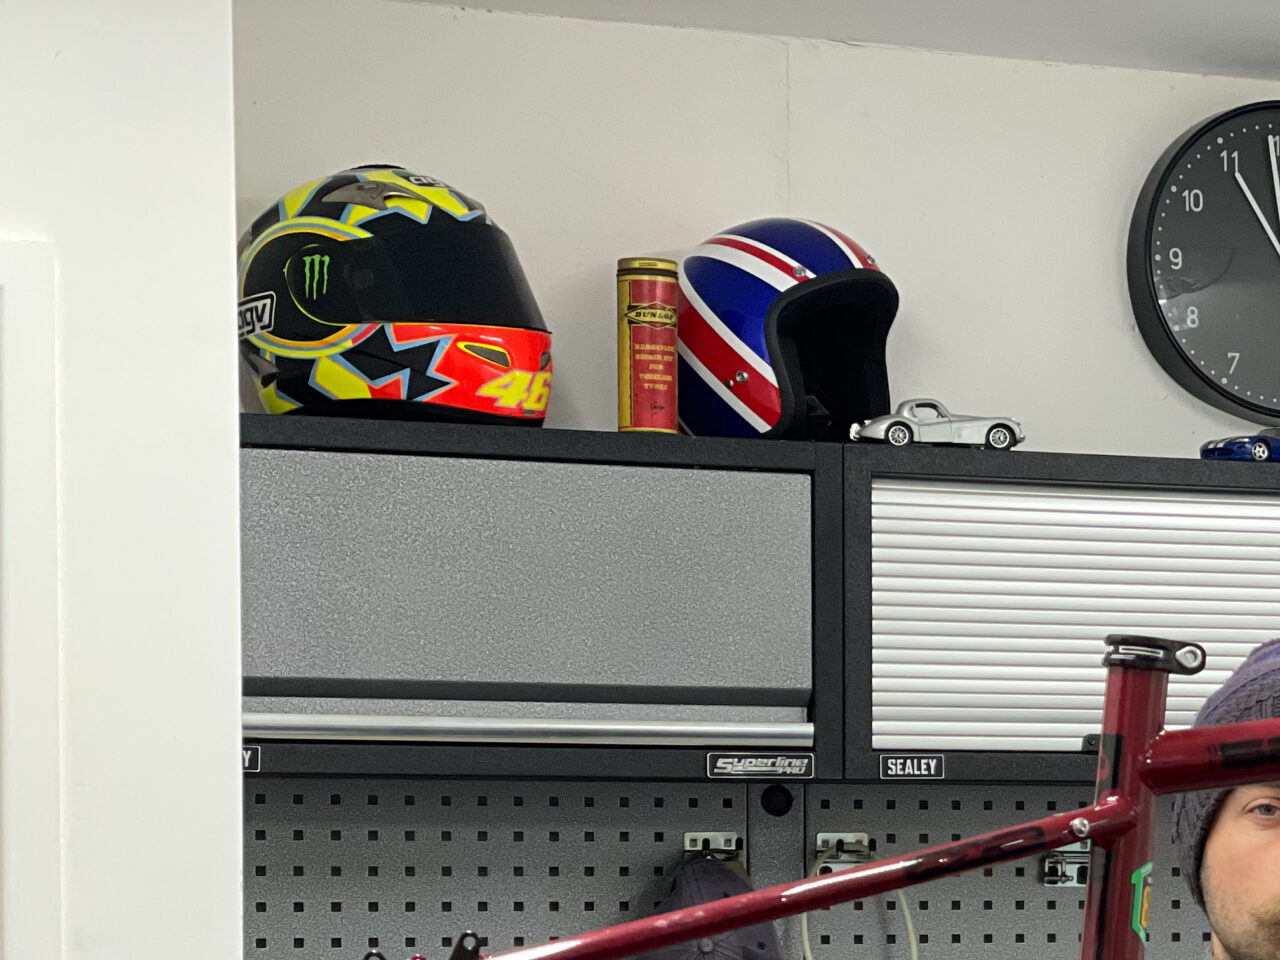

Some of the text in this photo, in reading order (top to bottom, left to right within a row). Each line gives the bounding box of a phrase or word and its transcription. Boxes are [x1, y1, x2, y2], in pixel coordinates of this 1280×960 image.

[1220, 150, 1239, 172] 11
[1181, 189, 1204, 212] 10
[1169, 248, 1183, 269] 9
[634, 310, 675, 321] DUNLOP
[1186, 306, 1199, 328] 8
[1226, 353, 1240, 374] 7
[475, 369, 552, 411] 46
[713, 756, 809, 774] Superline
[887, 758, 937, 775] SEALEY
